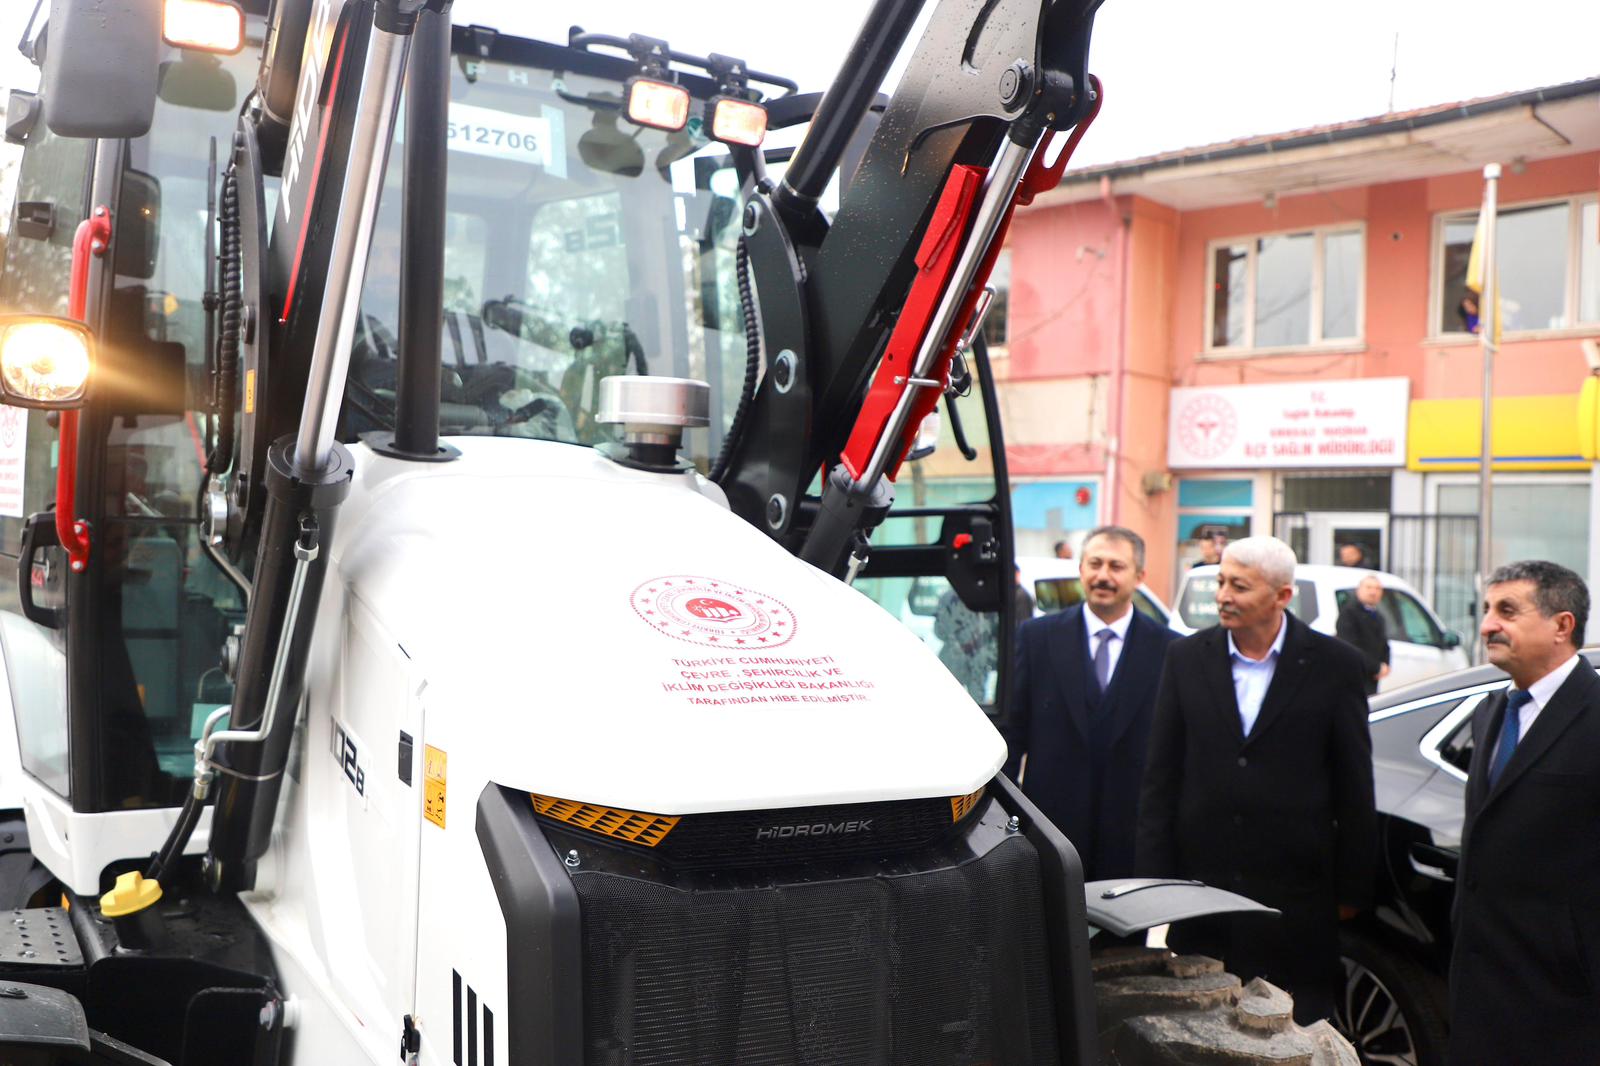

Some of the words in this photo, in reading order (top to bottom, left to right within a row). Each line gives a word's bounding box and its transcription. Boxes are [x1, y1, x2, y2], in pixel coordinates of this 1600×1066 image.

[672, 656, 736, 667] TÜRKİYE
[739, 654, 834, 666] CUMHURİYETİ
[680, 669, 732, 680] ÇEVRE
[742, 667, 822, 678] ŞEHİRCİLİK
[823, 667, 844, 676] VE
[662, 681, 705, 692] İKLİM
[707, 679, 796, 693] DEĞİŞİKLİĞİ
[798, 678, 876, 690] BAKANLIĞI
[687, 695, 769, 706] TARAFINDAN
[769, 693, 799, 703] HİBE
